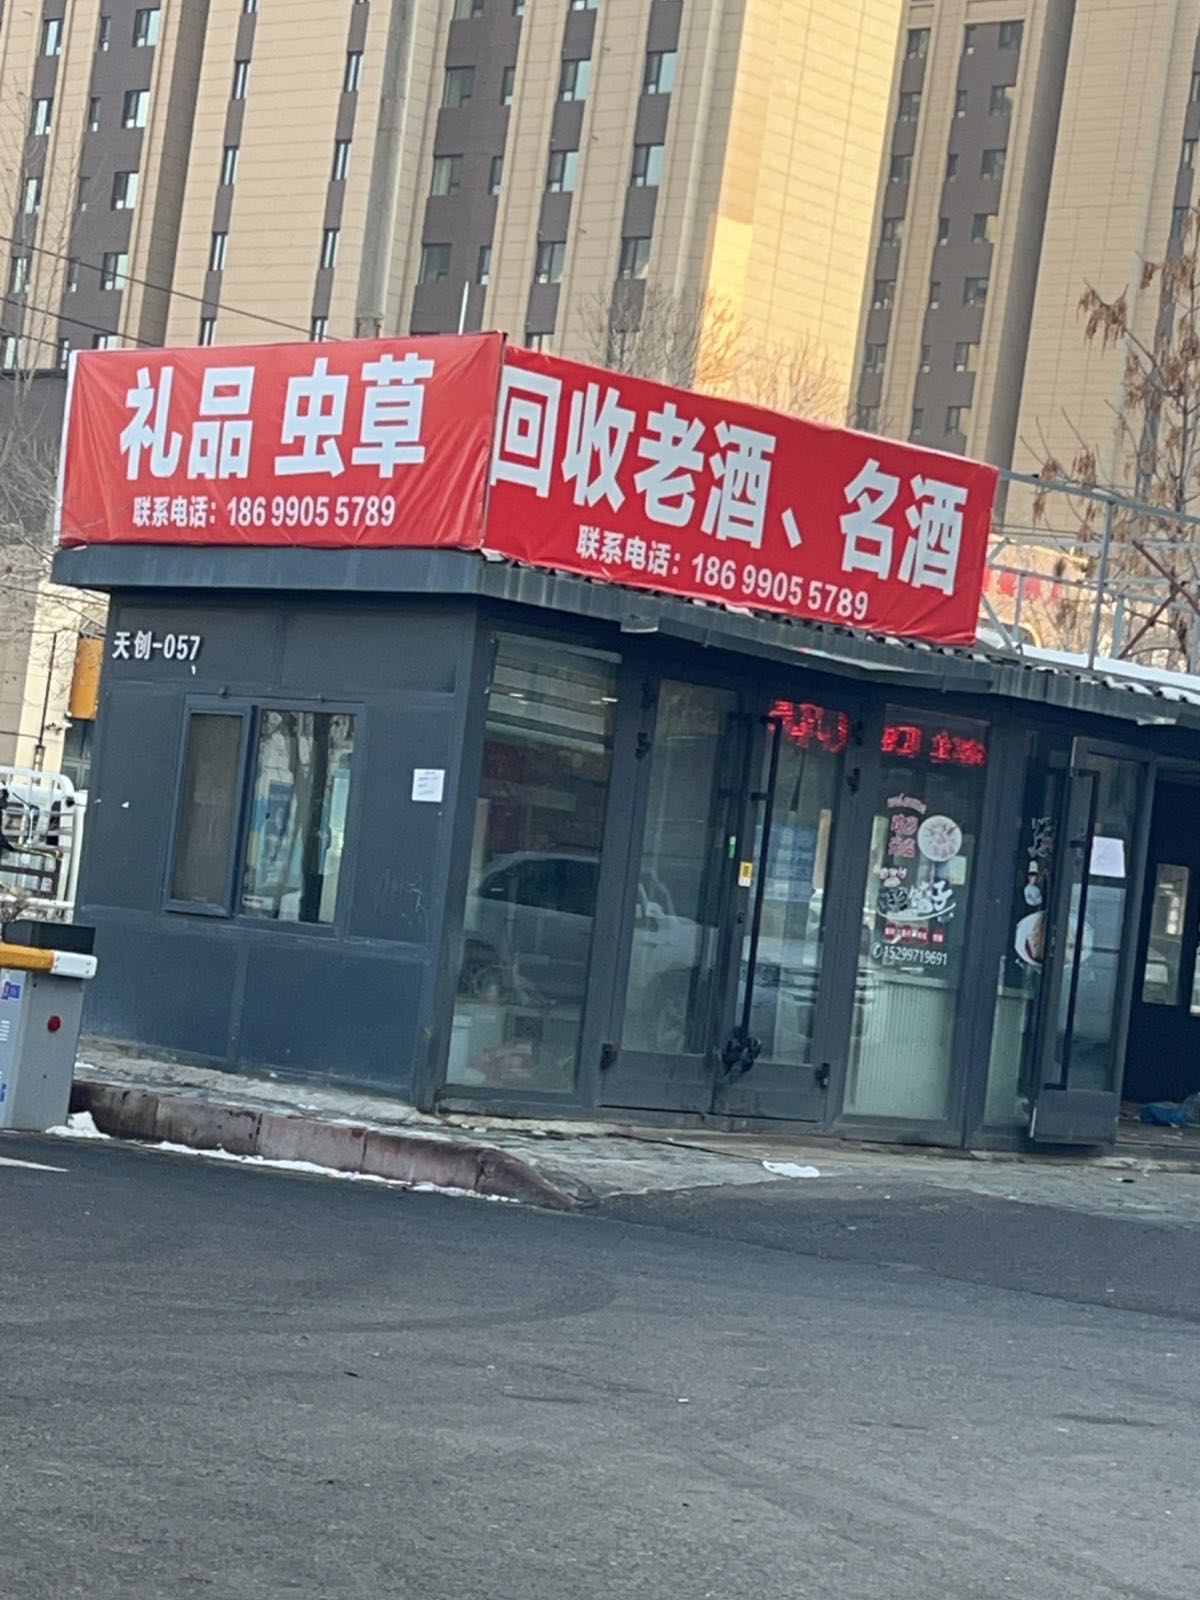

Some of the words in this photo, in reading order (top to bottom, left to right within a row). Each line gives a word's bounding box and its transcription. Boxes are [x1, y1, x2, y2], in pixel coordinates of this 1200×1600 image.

[120, 366, 256, 480] 礼品
[274, 352, 436, 479] 虫草
[227, 495, 267, 527] 186
[271, 495, 330, 527] 9905
[334, 494, 396, 527] 5789
[692, 553, 736, 590] 186
[742, 564, 803, 605] 9905
[808, 580, 869, 620] 5789
[112, 630, 202, 661] 天创-057
